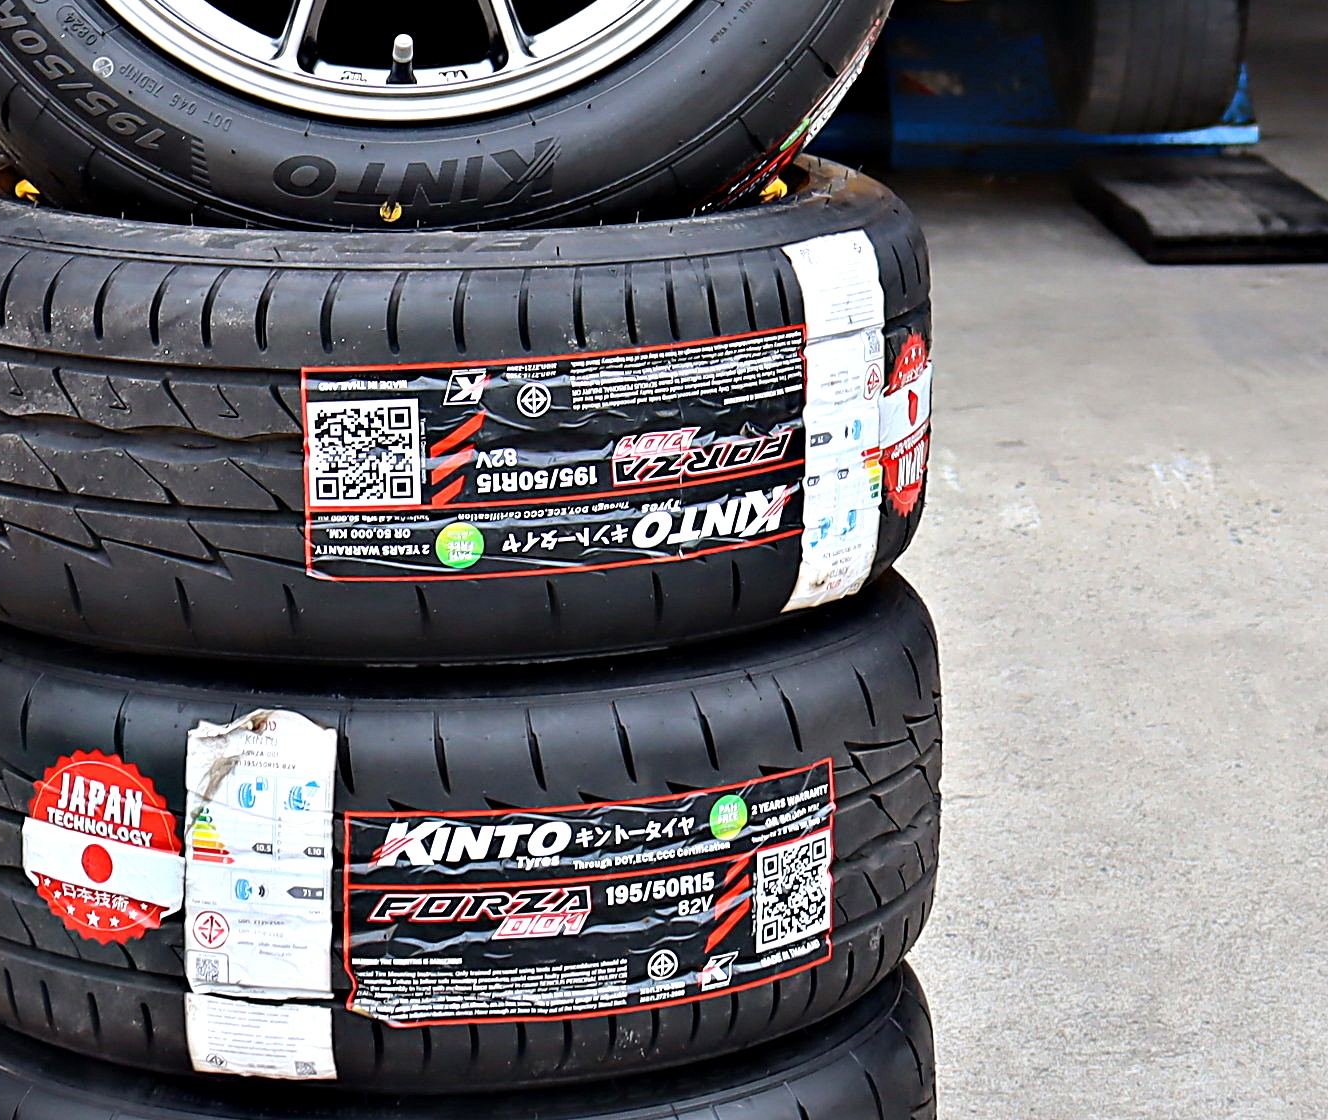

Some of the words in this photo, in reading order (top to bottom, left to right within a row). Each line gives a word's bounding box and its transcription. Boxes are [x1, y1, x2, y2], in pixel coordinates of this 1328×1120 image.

[201, 108, 234, 133] DOT
[272, 137, 561, 210] KINTO
[318, 379, 367, 390] THAILAND
[369, 379, 381, 390] IN
[383, 379, 407, 390] MADE
[474, 447, 517, 468] 82V
[610, 429, 793, 486] FORZA
[476, 465, 597, 493] 195/50R15
[631, 482, 791, 547] KINTO
[640, 498, 681, 512] Tyres
[326, 529, 348, 539] KM.
[351, 527, 392, 539] 50,000
[394, 529, 411, 539] OR
[501, 523, 629, 552] キントータイヤ
[315, 545, 380, 556] WARRANTY
[381, 544, 421, 556] YEARS
[422, 544, 430, 555] 2
[56, 772, 143, 829] JAPAN
[751, 804, 758, 815] 2
[759, 797, 786, 814] YEARS
[786, 783, 829, 807] WARRANTY
[46, 806, 154, 848] TECHNOLOGY
[575, 815, 695, 849] キントータイヤ
[372, 820, 572, 868] KINTO
[573, 857, 614, 872] Through
[676, 841, 731, 859] Certification
[516, 855, 561, 871] Tyres
[60, 884, 130, 914] 日本技術
[368, 886, 591, 922] FORZA
[606, 874, 715, 906] 195/50R15
[677, 895, 713, 916] 82V
[492, 912, 589, 940] 001
